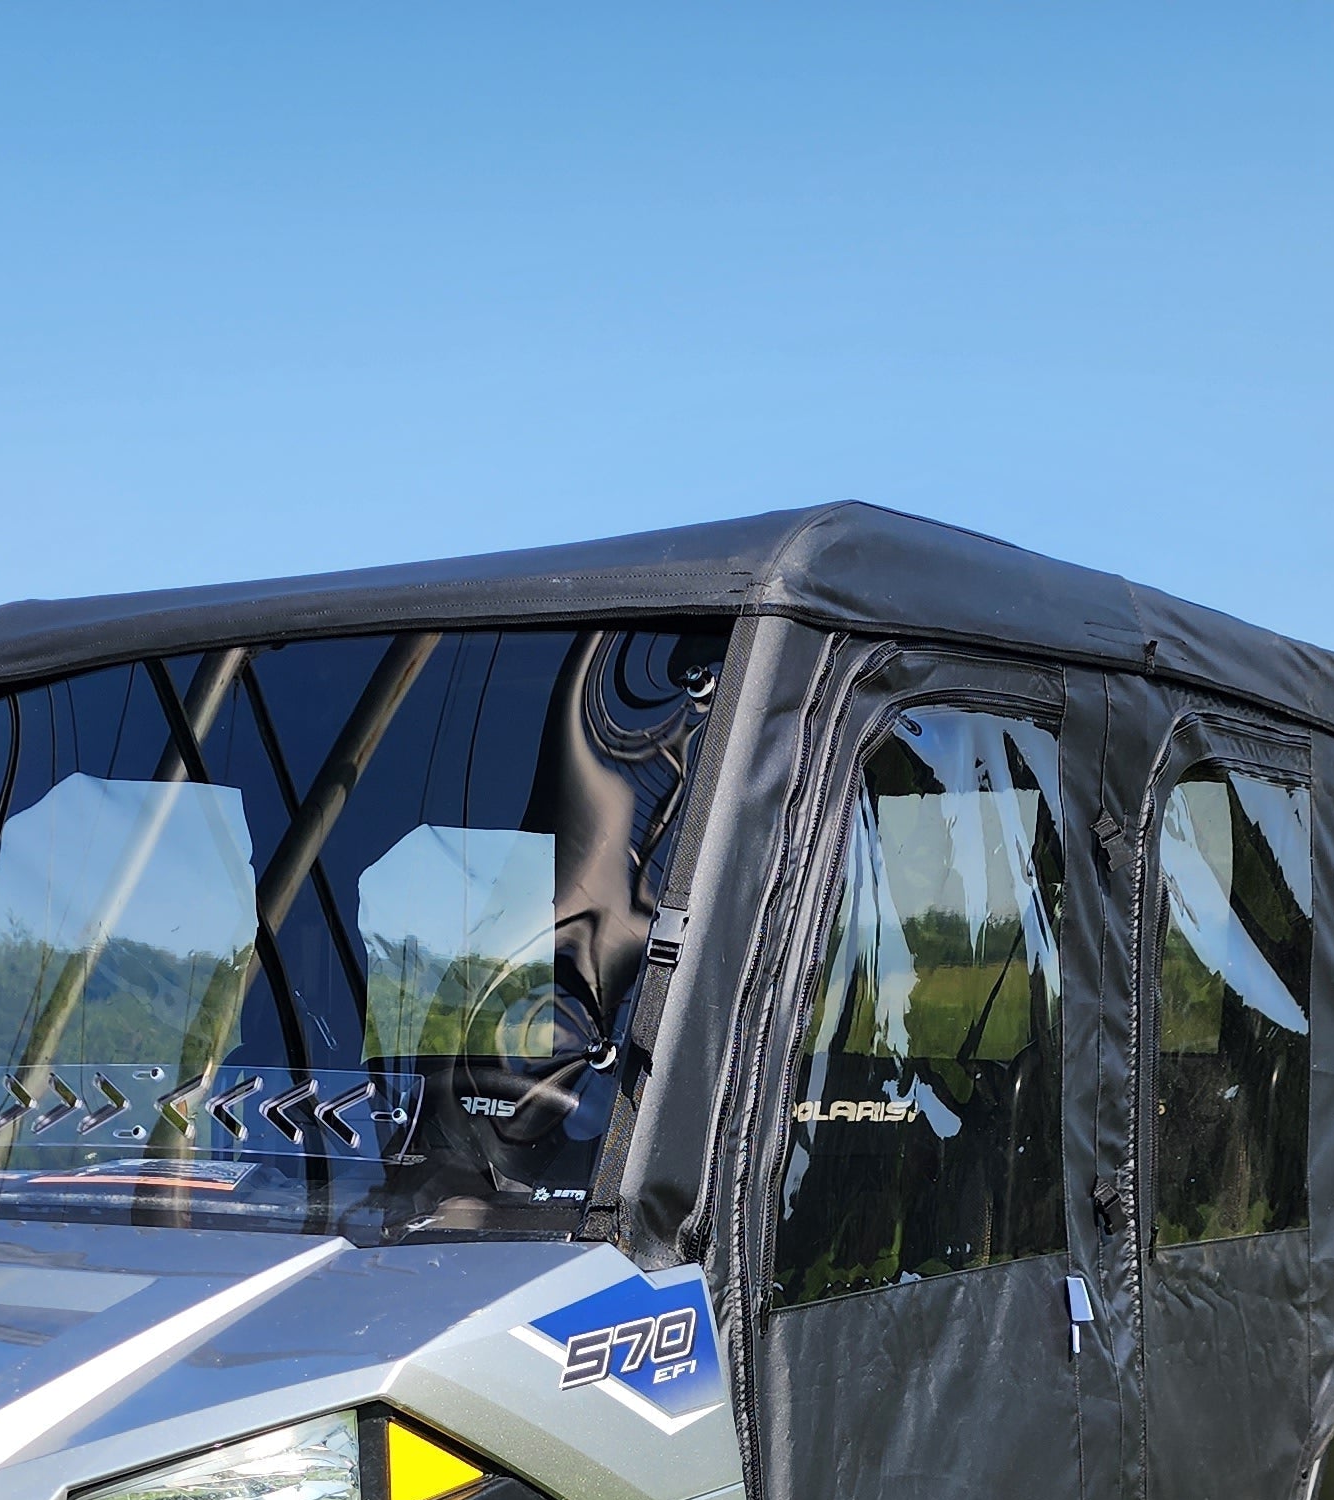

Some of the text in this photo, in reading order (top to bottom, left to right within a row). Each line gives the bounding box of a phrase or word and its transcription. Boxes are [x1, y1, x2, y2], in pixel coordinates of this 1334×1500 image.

[792, 1100, 912, 1122] OLARIS
[559, 1307, 697, 1391] 570
[653, 1359, 697, 1384] EFI
